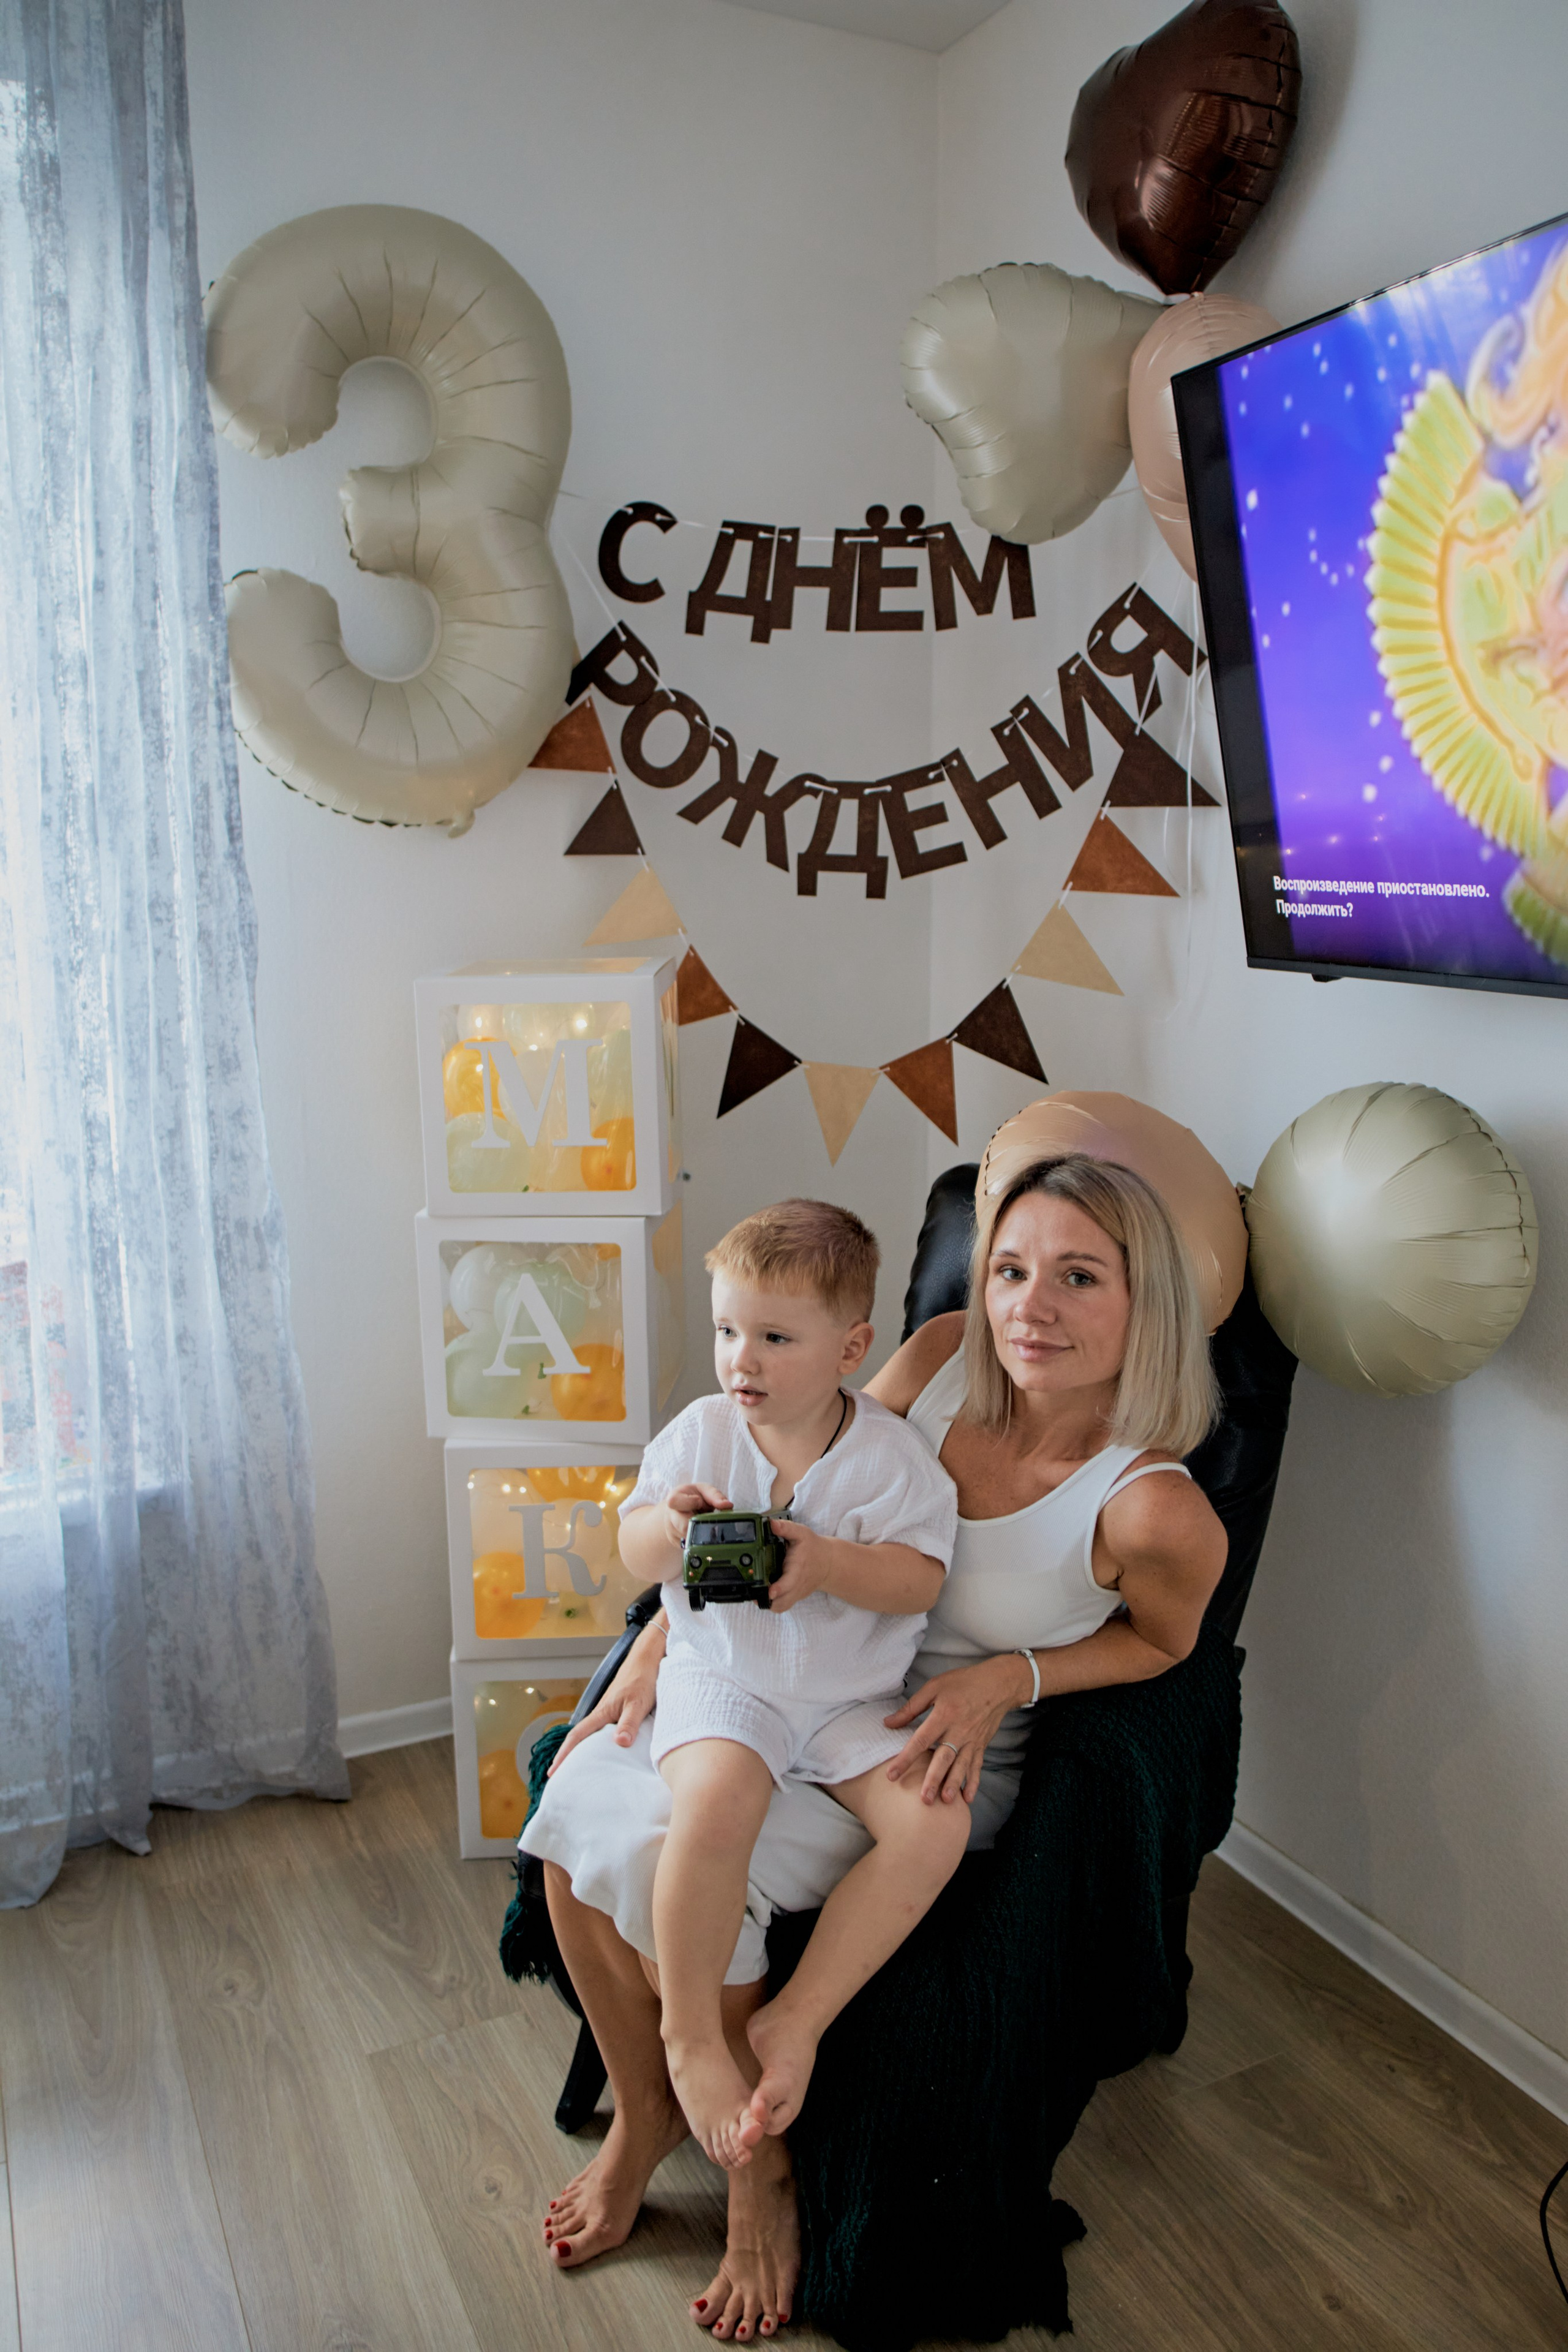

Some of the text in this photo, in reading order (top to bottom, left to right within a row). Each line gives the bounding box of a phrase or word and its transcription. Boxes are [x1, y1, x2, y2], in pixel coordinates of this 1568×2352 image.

[204, 203, 573, 838] 3
[598, 501, 1036, 644] С ДНЁМ
[565, 581, 1208, 899] РОЖДЕНИЯ
[1273, 876, 1490, 898] Воспроизведение приостановлено.
[1276, 899, 1354, 918] Продолжить?
